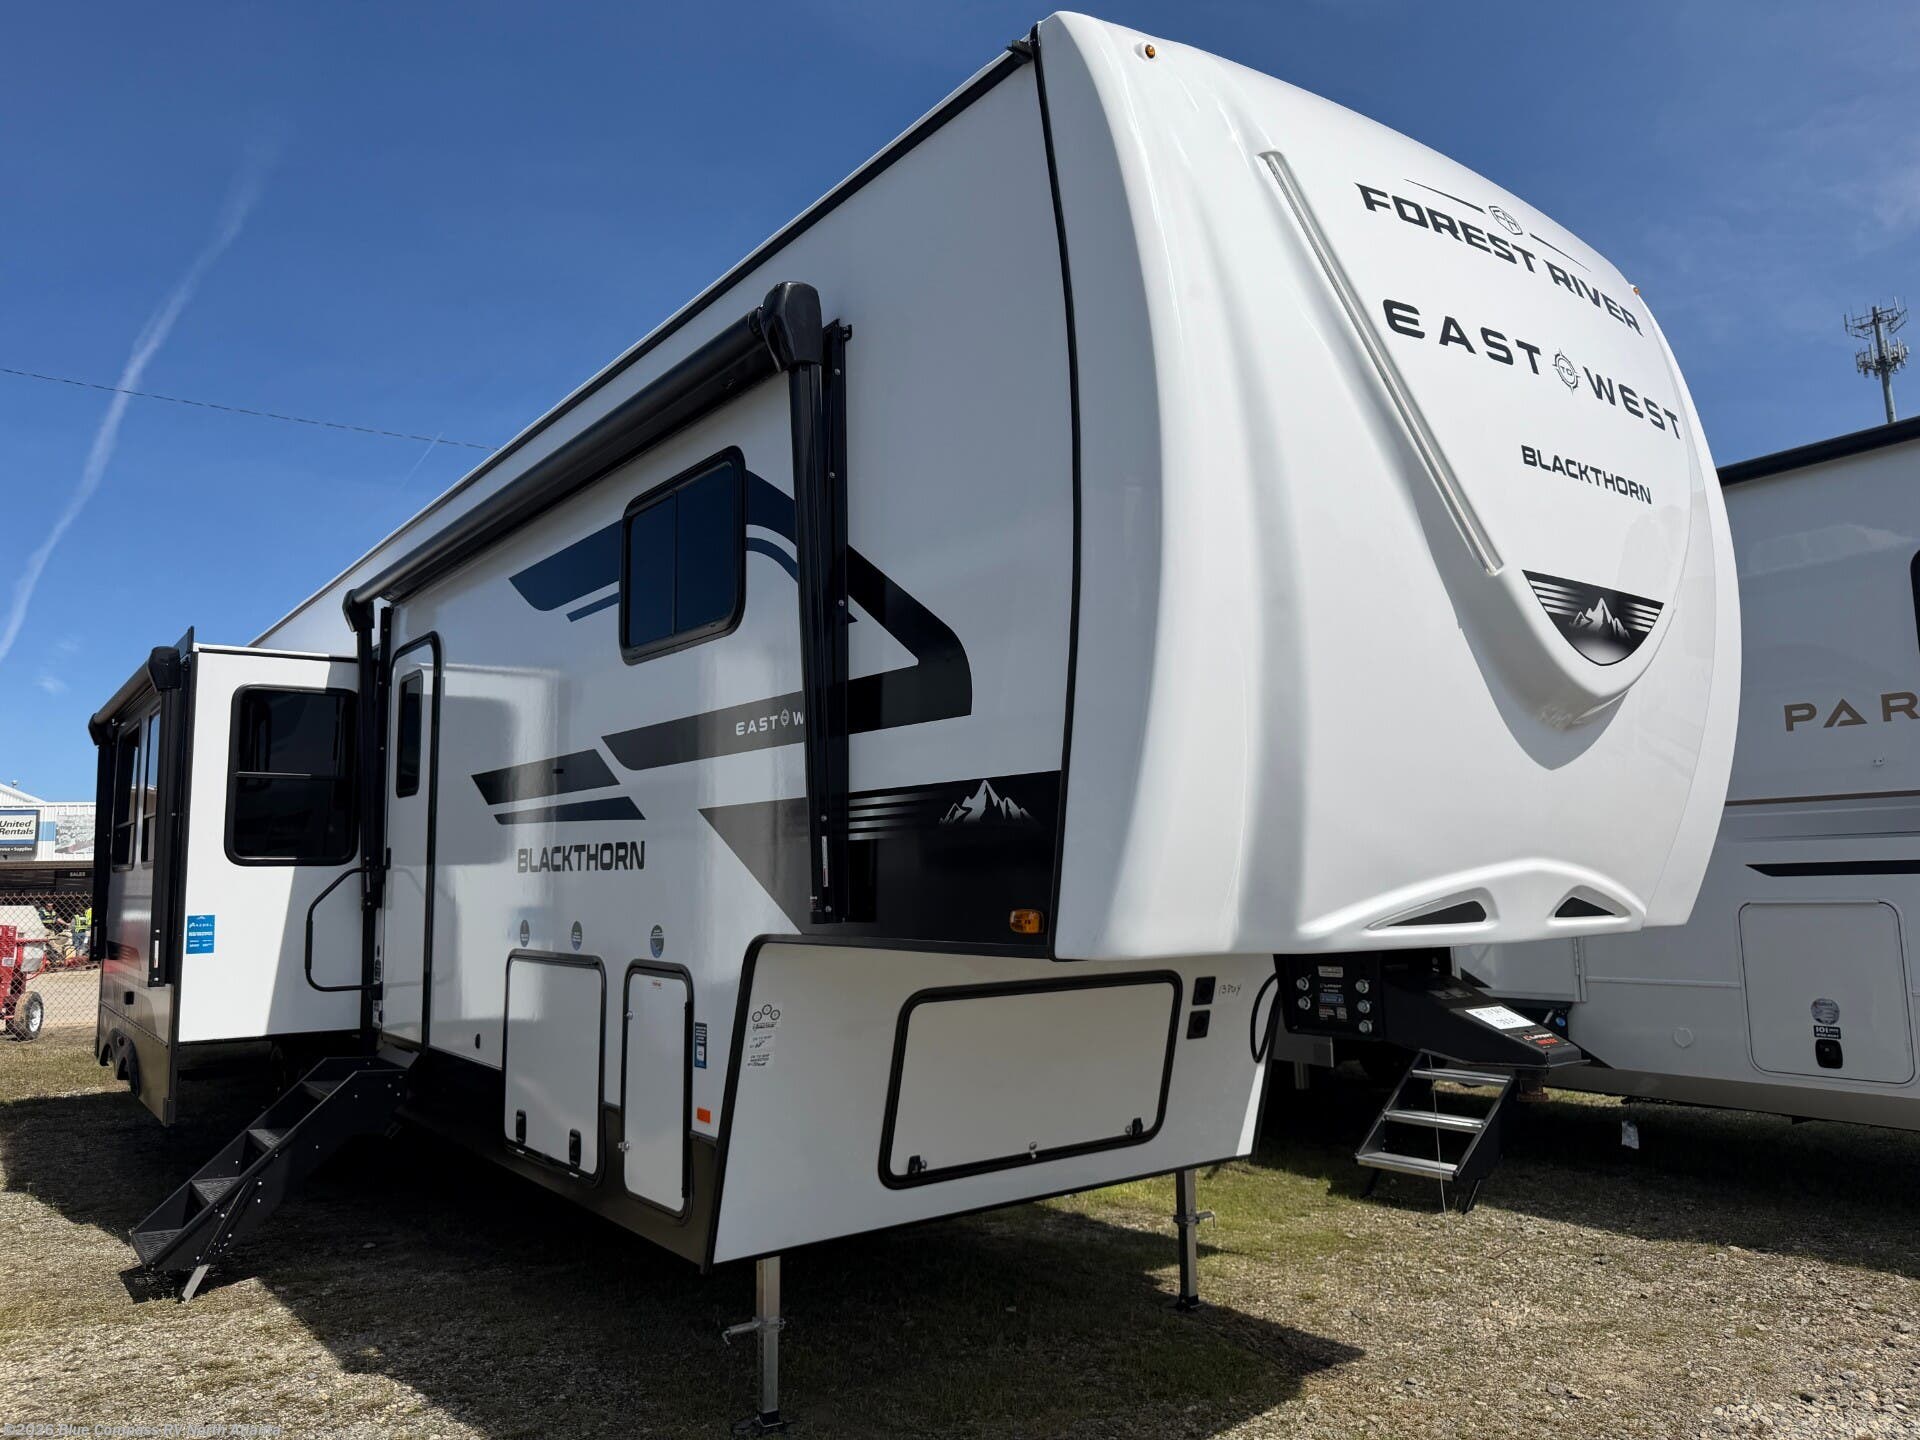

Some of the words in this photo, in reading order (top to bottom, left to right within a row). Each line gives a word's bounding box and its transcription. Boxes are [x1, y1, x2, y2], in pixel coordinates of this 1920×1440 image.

[1355, 182, 1536, 273] FOREST
[1543, 259, 1644, 337] RIVER
[1383, 299, 1541, 375] EAST
[1582, 365, 1680, 440] WEST
[1520, 444, 1652, 504] BLACKTHORN
[736, 715, 778, 735] EAST
[0, 820, 32, 828] United
[518, 841, 645, 873] BLACKTHORN
